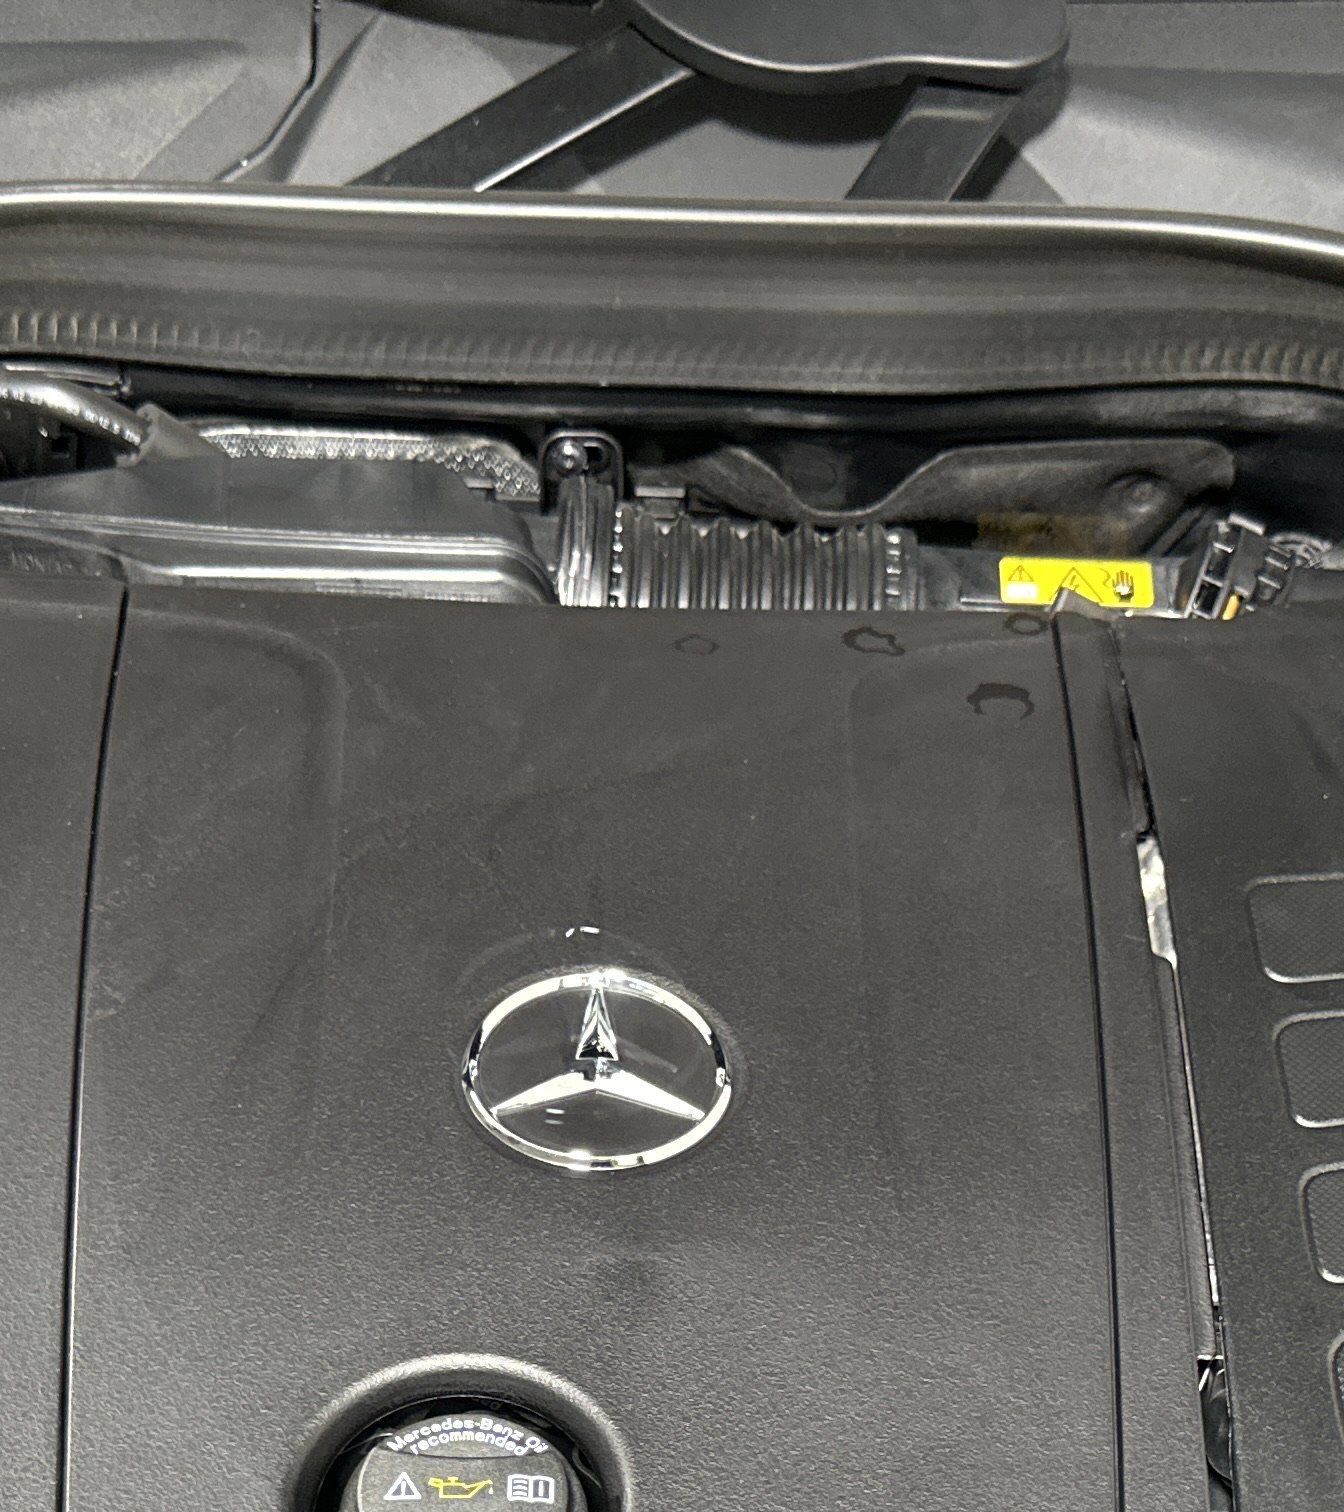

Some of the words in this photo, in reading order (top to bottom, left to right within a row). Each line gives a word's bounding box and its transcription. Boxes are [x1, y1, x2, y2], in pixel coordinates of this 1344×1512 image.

[386, 1417, 524, 1452] Mercedes-Benz
[525, 1437, 549, 1454] Oil
[409, 1430, 528, 1456] recommended
